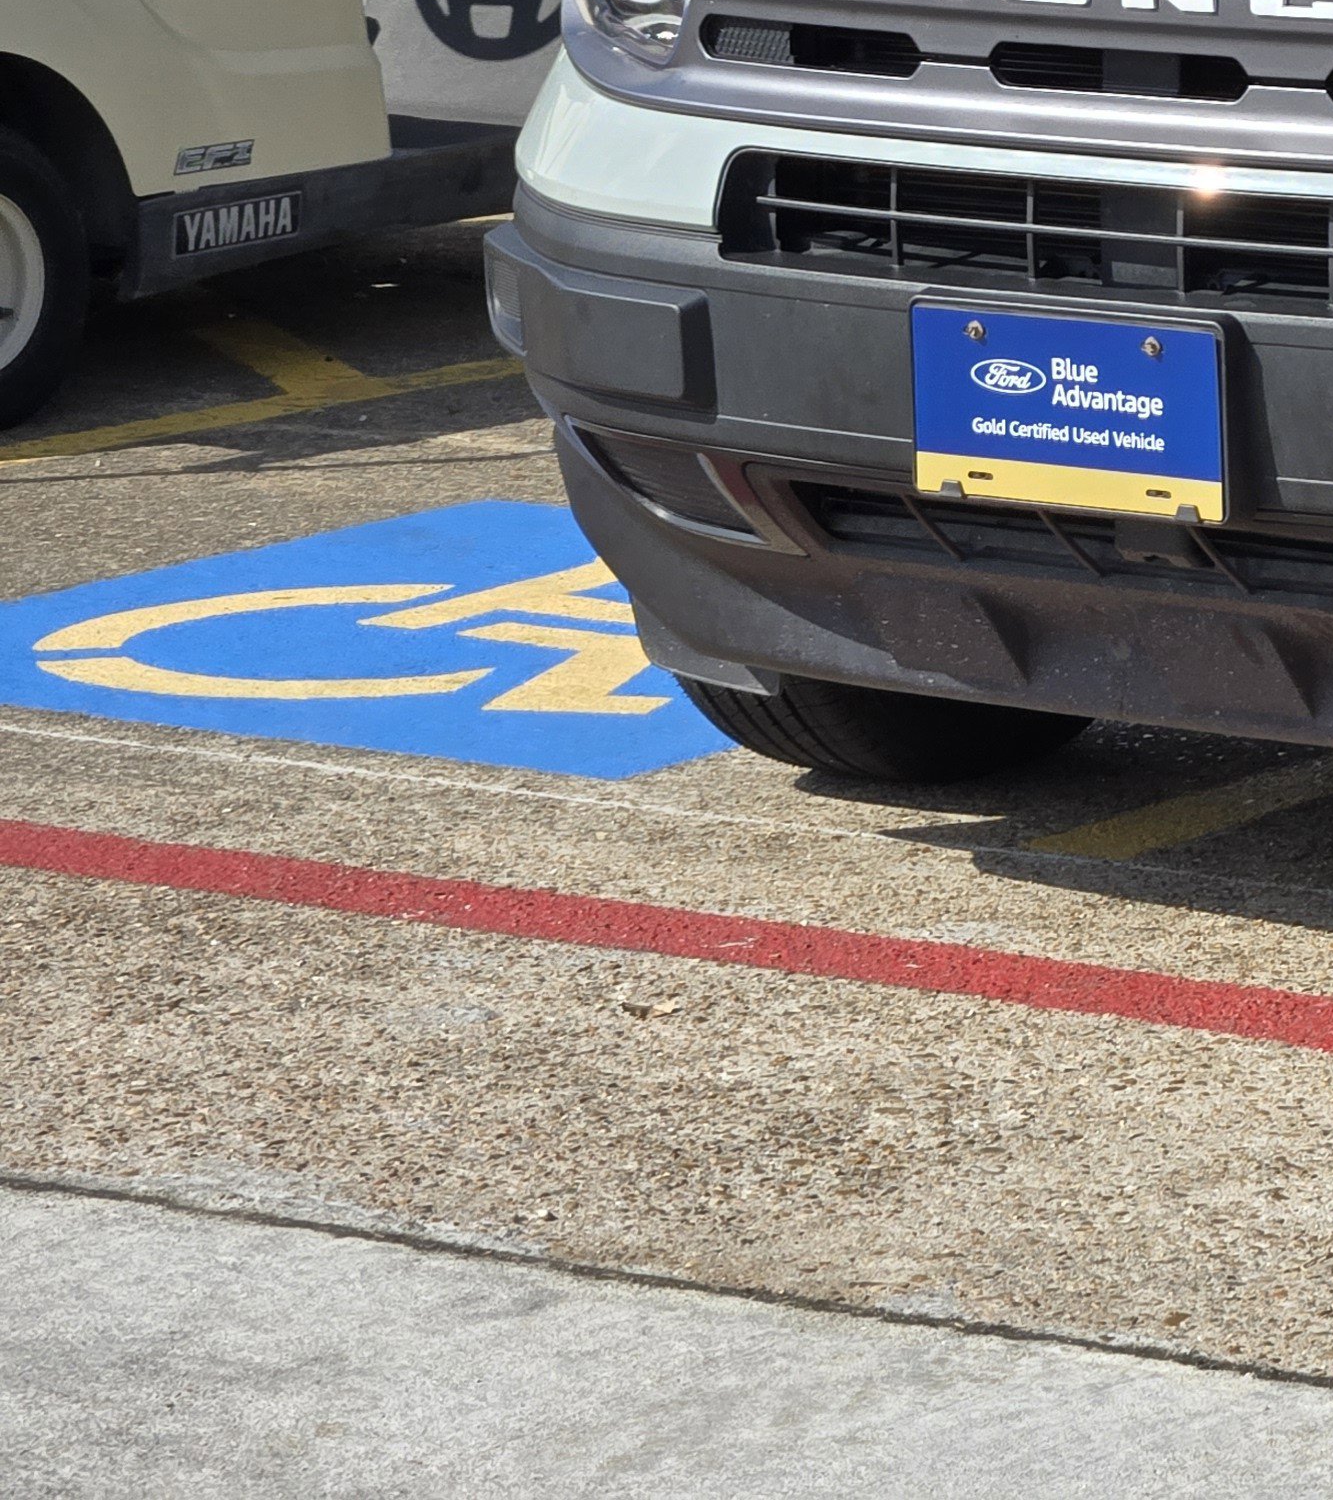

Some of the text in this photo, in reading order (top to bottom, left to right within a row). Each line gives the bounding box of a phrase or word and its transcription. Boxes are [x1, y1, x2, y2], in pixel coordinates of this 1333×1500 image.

[184, 197, 292, 251] YAMAHA
[984, 362, 1032, 390] Ford
[1051, 357, 1098, 383] Blue
[1052, 384, 1163, 419] Advantage
[972, 416, 1165, 451] Gold Certified Used Vehicle
